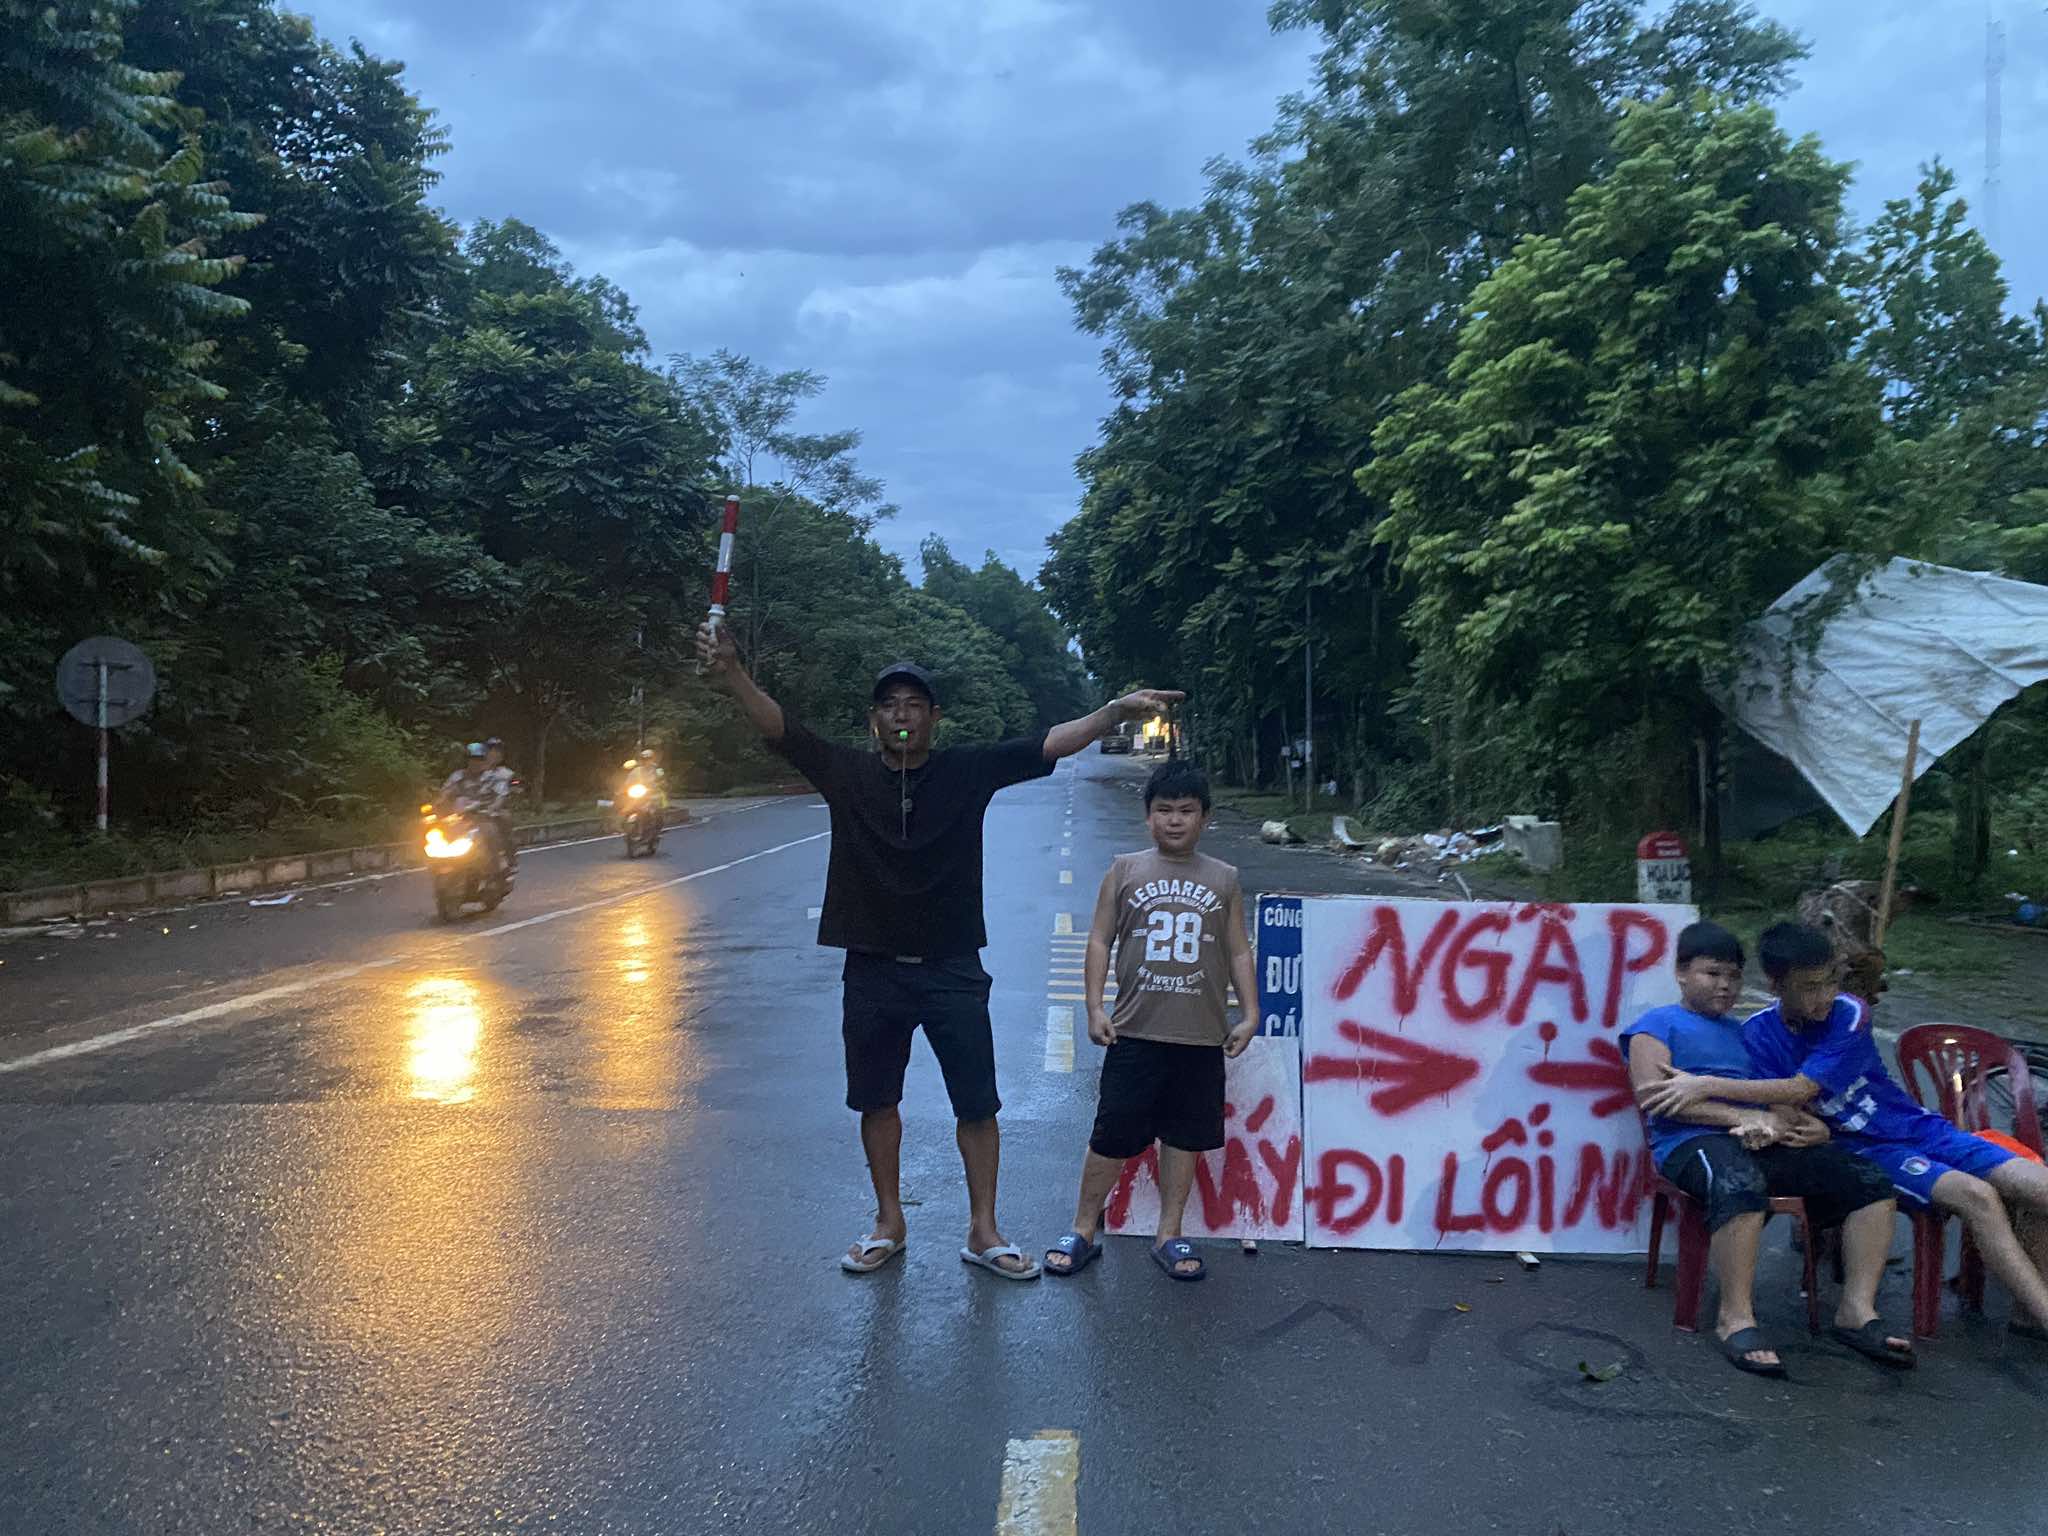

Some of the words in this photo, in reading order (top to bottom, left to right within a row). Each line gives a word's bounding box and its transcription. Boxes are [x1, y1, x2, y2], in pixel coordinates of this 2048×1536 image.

[1128, 879, 1223, 913] LEGDARENY
[1145, 911, 1202, 963] 28
[1266, 953, 1302, 994] ĐƯ
[1332, 902, 1667, 1041] NGẬP
[1302, 1148, 1404, 1234] ĐI
